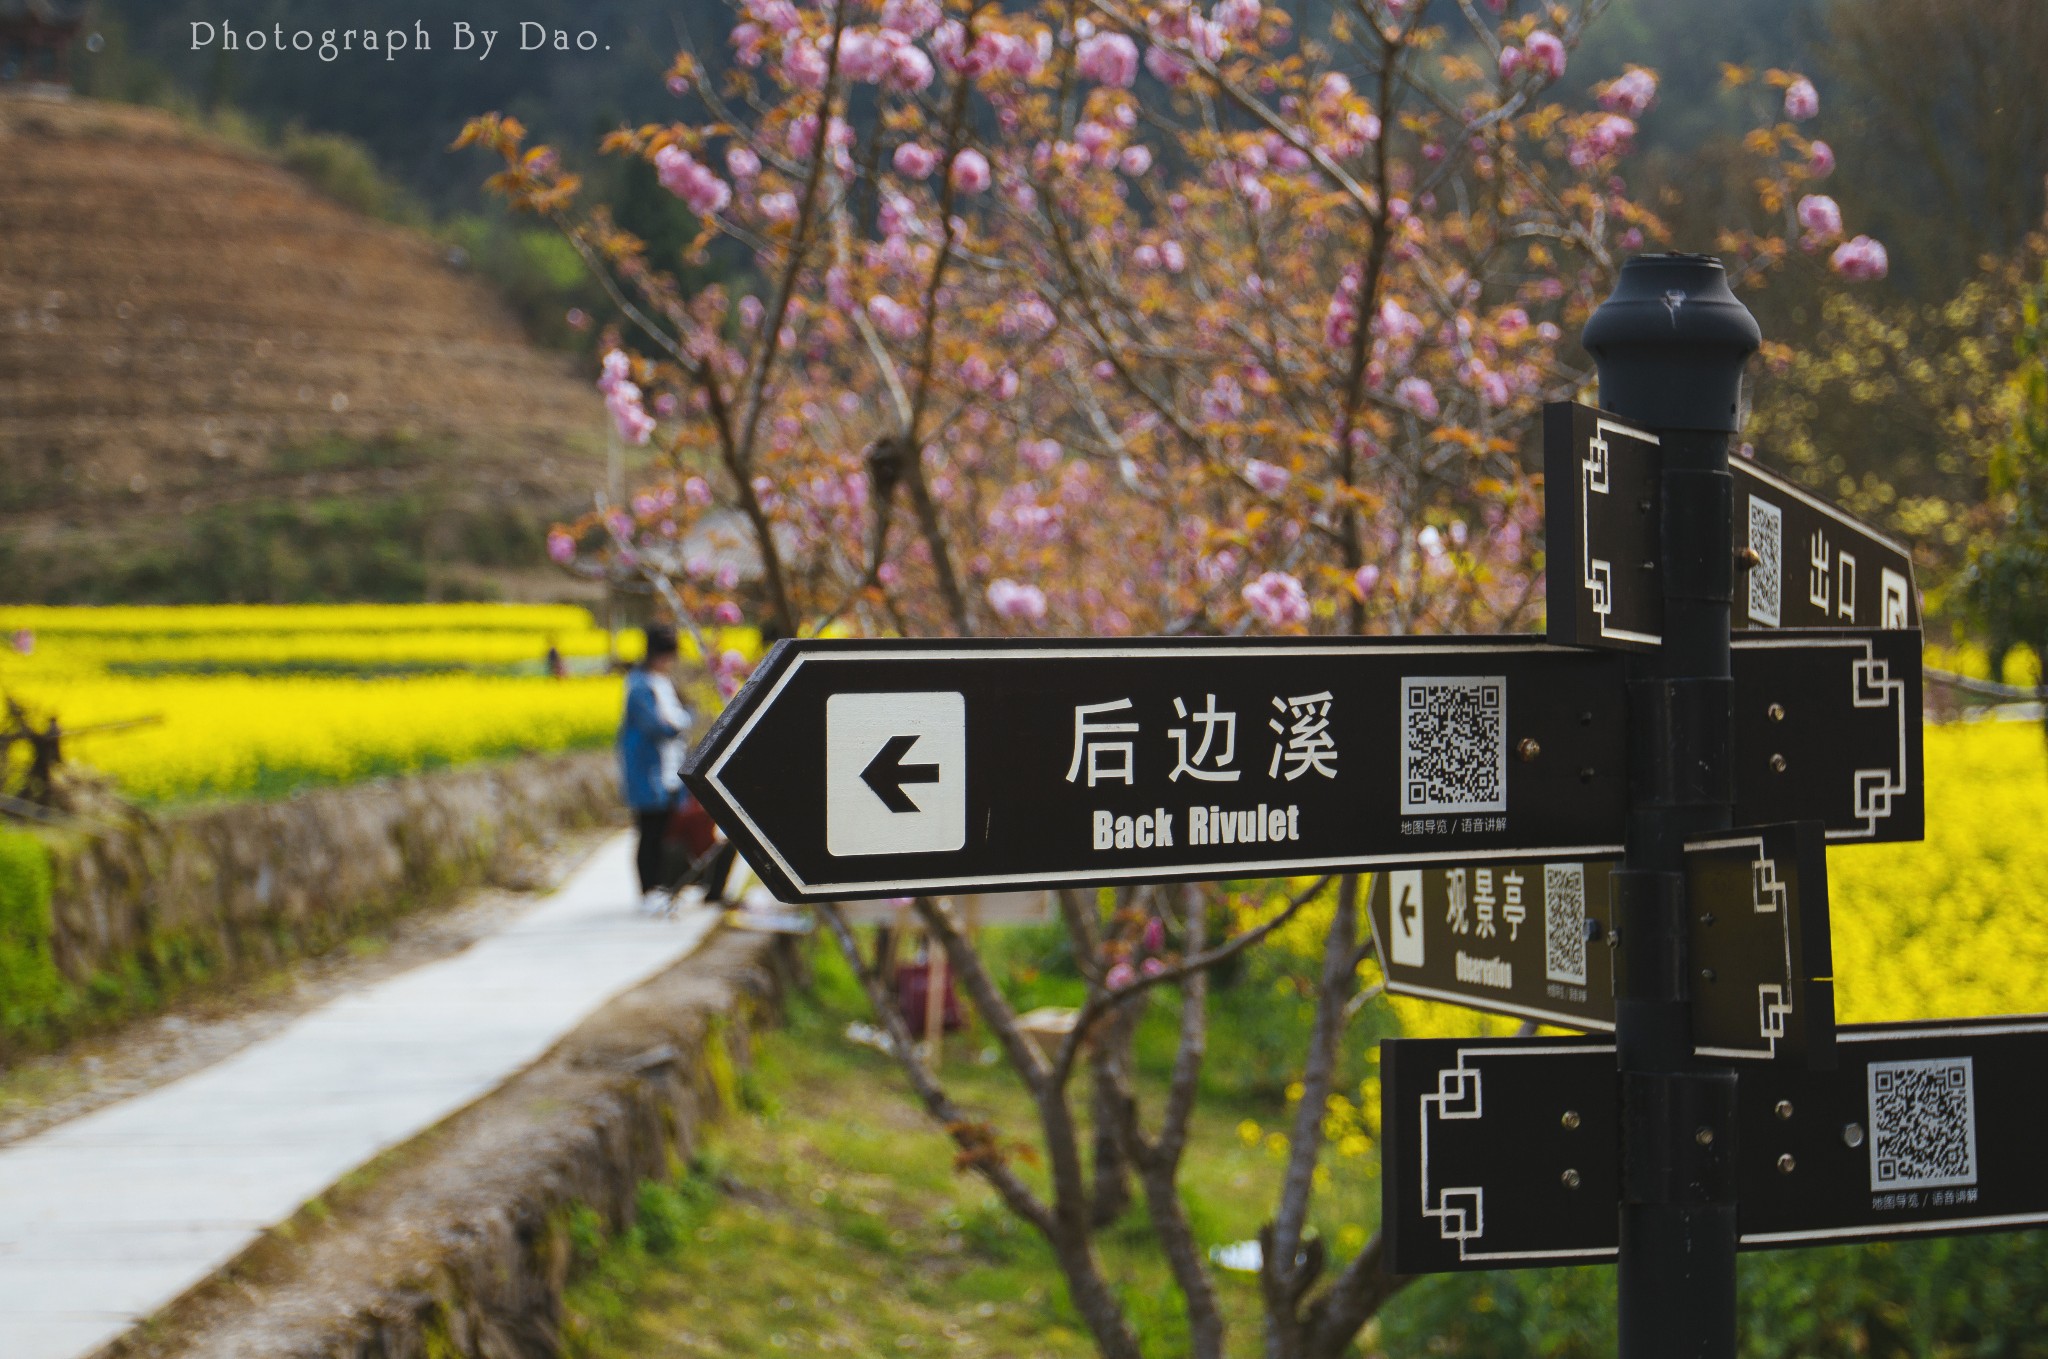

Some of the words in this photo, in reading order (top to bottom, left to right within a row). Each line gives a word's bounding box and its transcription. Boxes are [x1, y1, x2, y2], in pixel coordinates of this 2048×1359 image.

[1809, 527, 1856, 625] 出口
[1065, 690, 1338, 788] 后边溪
[1092, 807, 1174, 850] Back
[1188, 803, 1300, 846] Rivulet
[1445, 867, 1527, 942] 观景亭
